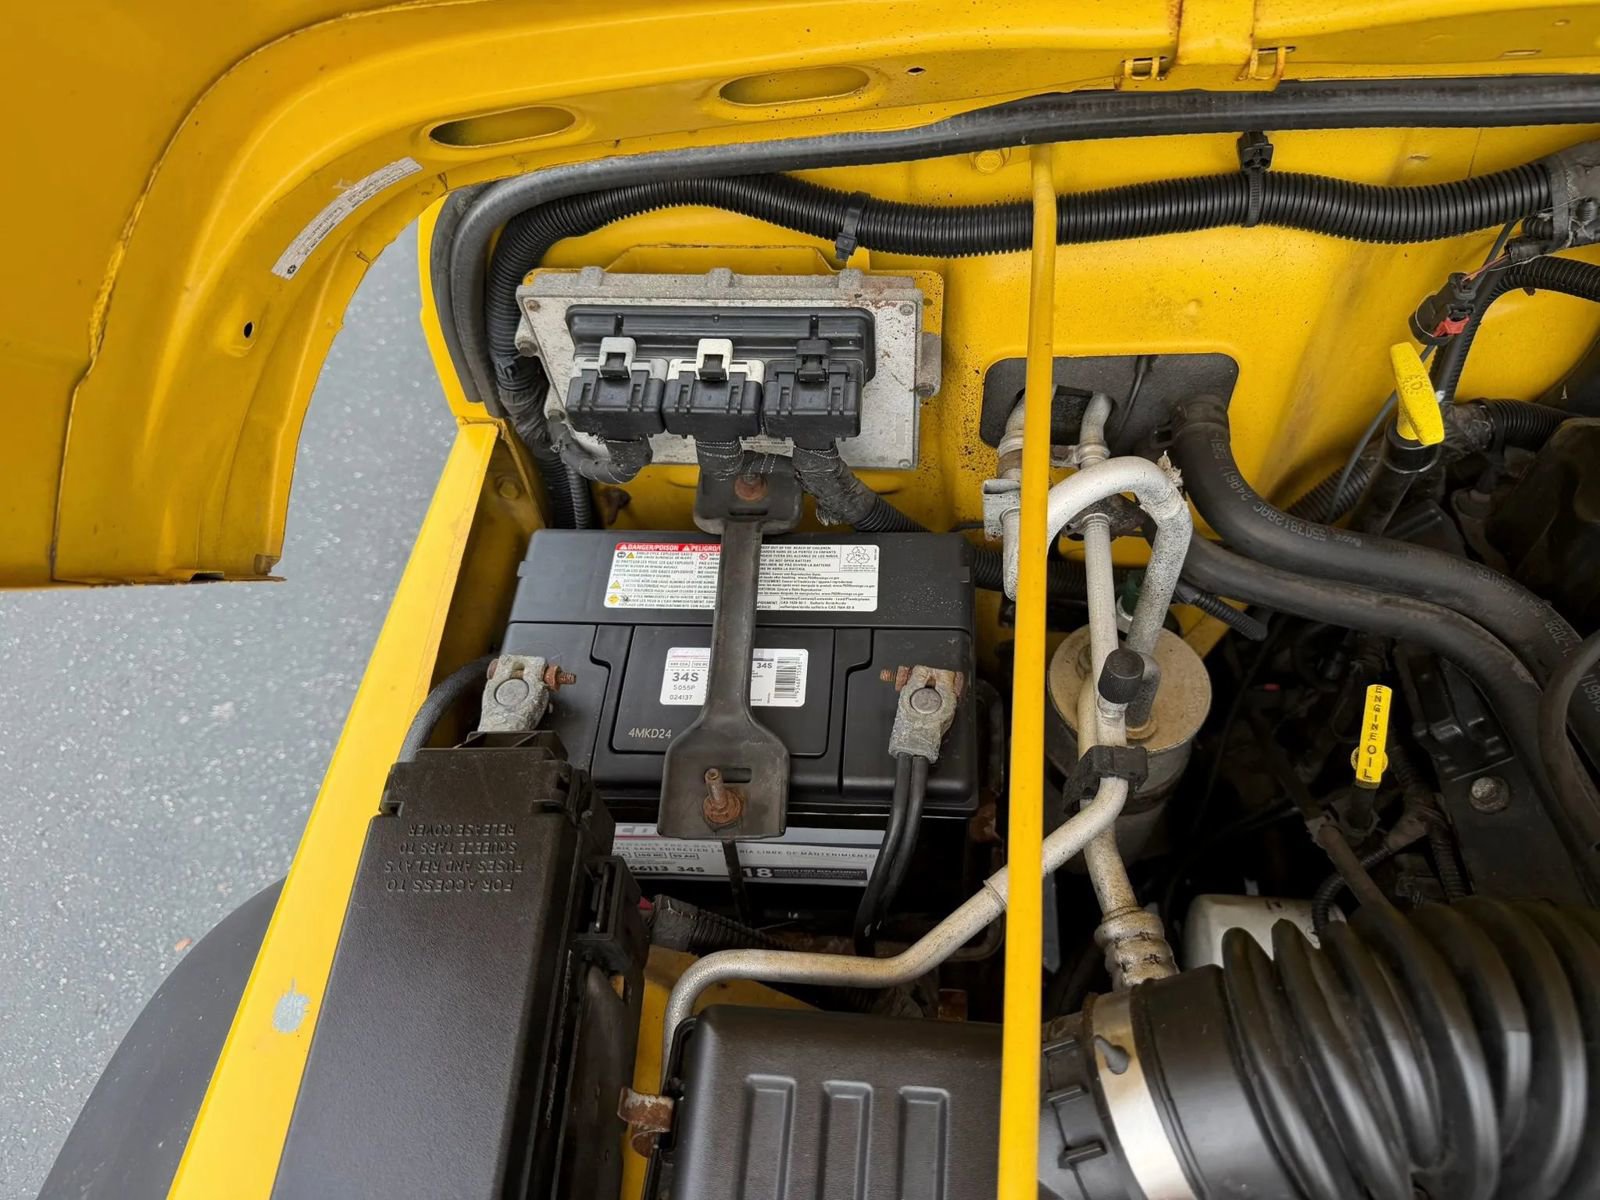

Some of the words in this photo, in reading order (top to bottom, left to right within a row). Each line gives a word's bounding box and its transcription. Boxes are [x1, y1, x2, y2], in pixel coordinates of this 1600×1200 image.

[627, 544, 680, 552] DANGER/POISON
[672, 672, 699, 682] 34S
[1368, 684, 1383, 741] ENGINE
[628, 728, 672, 739] 4MKD24
[1363, 744, 1378, 780] OIL
[408, 824, 453, 837] COVER
[456, 824, 517, 837] RELEASE
[400, 842, 416, 855] TO
[420, 842, 454, 855] TABS
[458, 842, 518, 855] SQUEEZE
[384, 860, 442, 874] RELAYS
[446, 860, 472, 874] AND
[478, 860, 524, 874] FUSES
[742, 868, 773, 878] 18
[385, 878, 407, 893] TO
[412, 878, 478, 893] ACCESS
[481, 878, 515, 893] FOR
